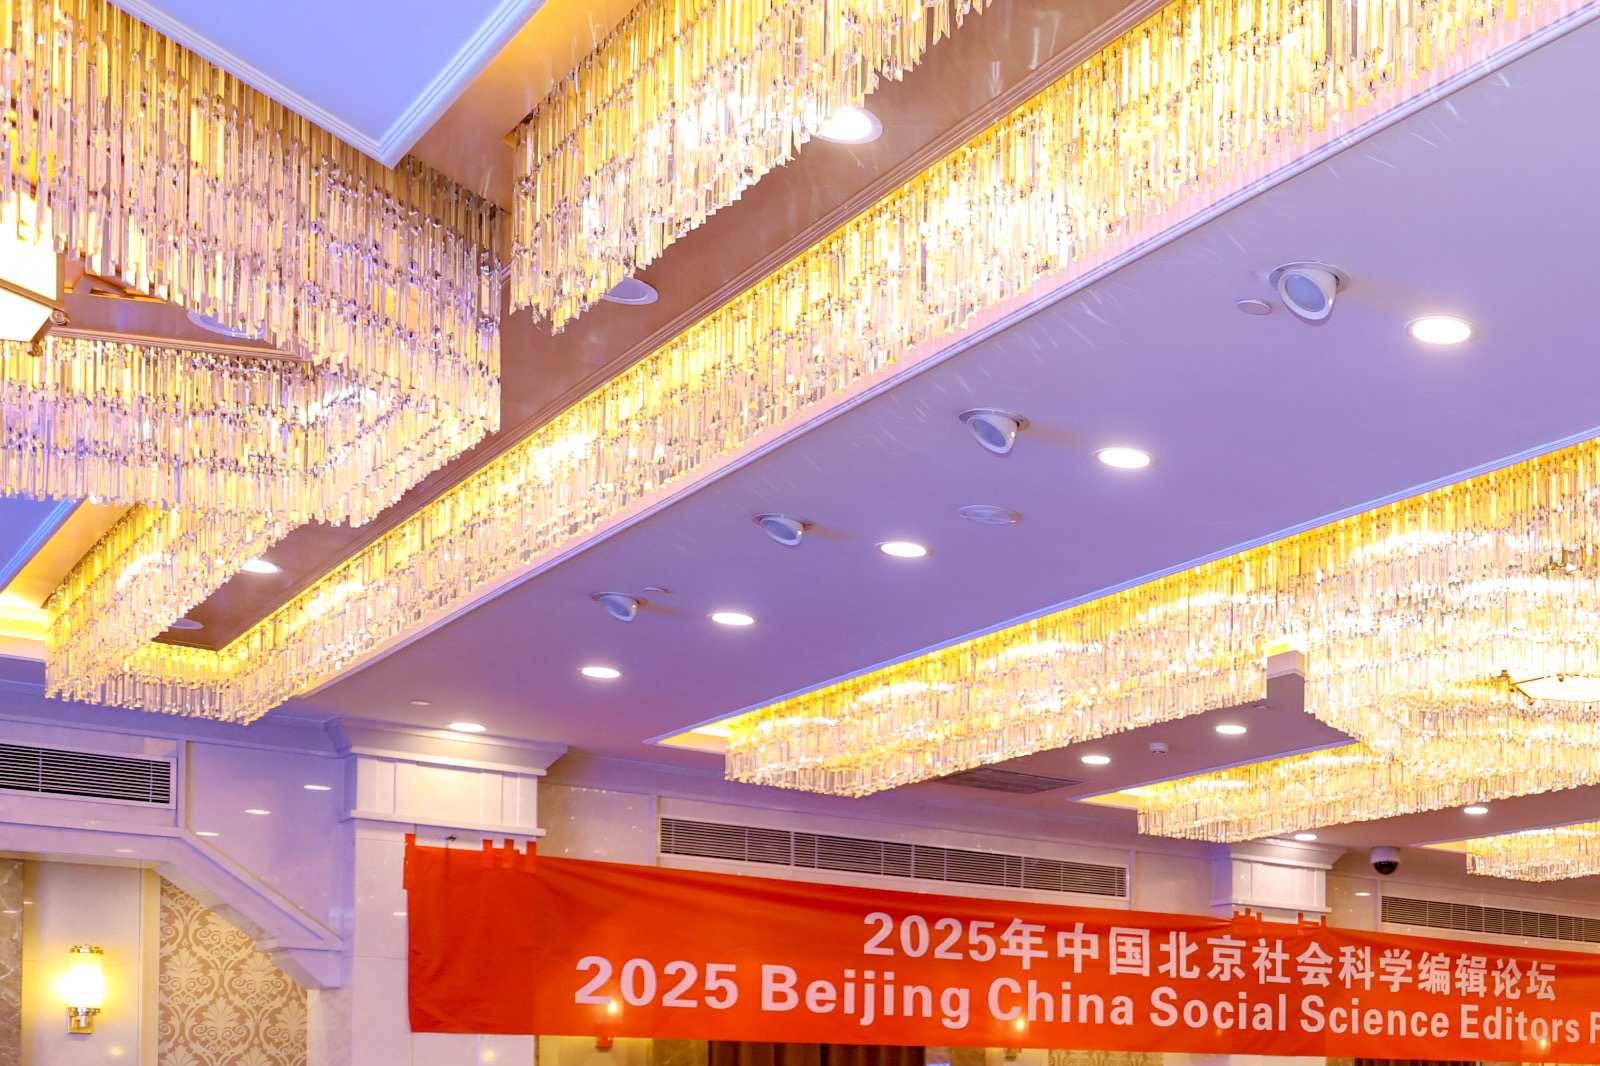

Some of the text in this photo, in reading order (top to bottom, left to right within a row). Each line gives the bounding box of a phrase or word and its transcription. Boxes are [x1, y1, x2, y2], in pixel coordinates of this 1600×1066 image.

[574, 955, 739, 1009] 2025
[761, 964, 970, 1029] Beijing
[988, 977, 1133, 1025] China
[1150, 986, 1287, 1031] Social
[1300, 994, 1449, 1038] Science
[1460, 1004, 1580, 1043] Editors
[863, 912, 1557, 1001] 2025年中国北京社会科学编辑论坛
